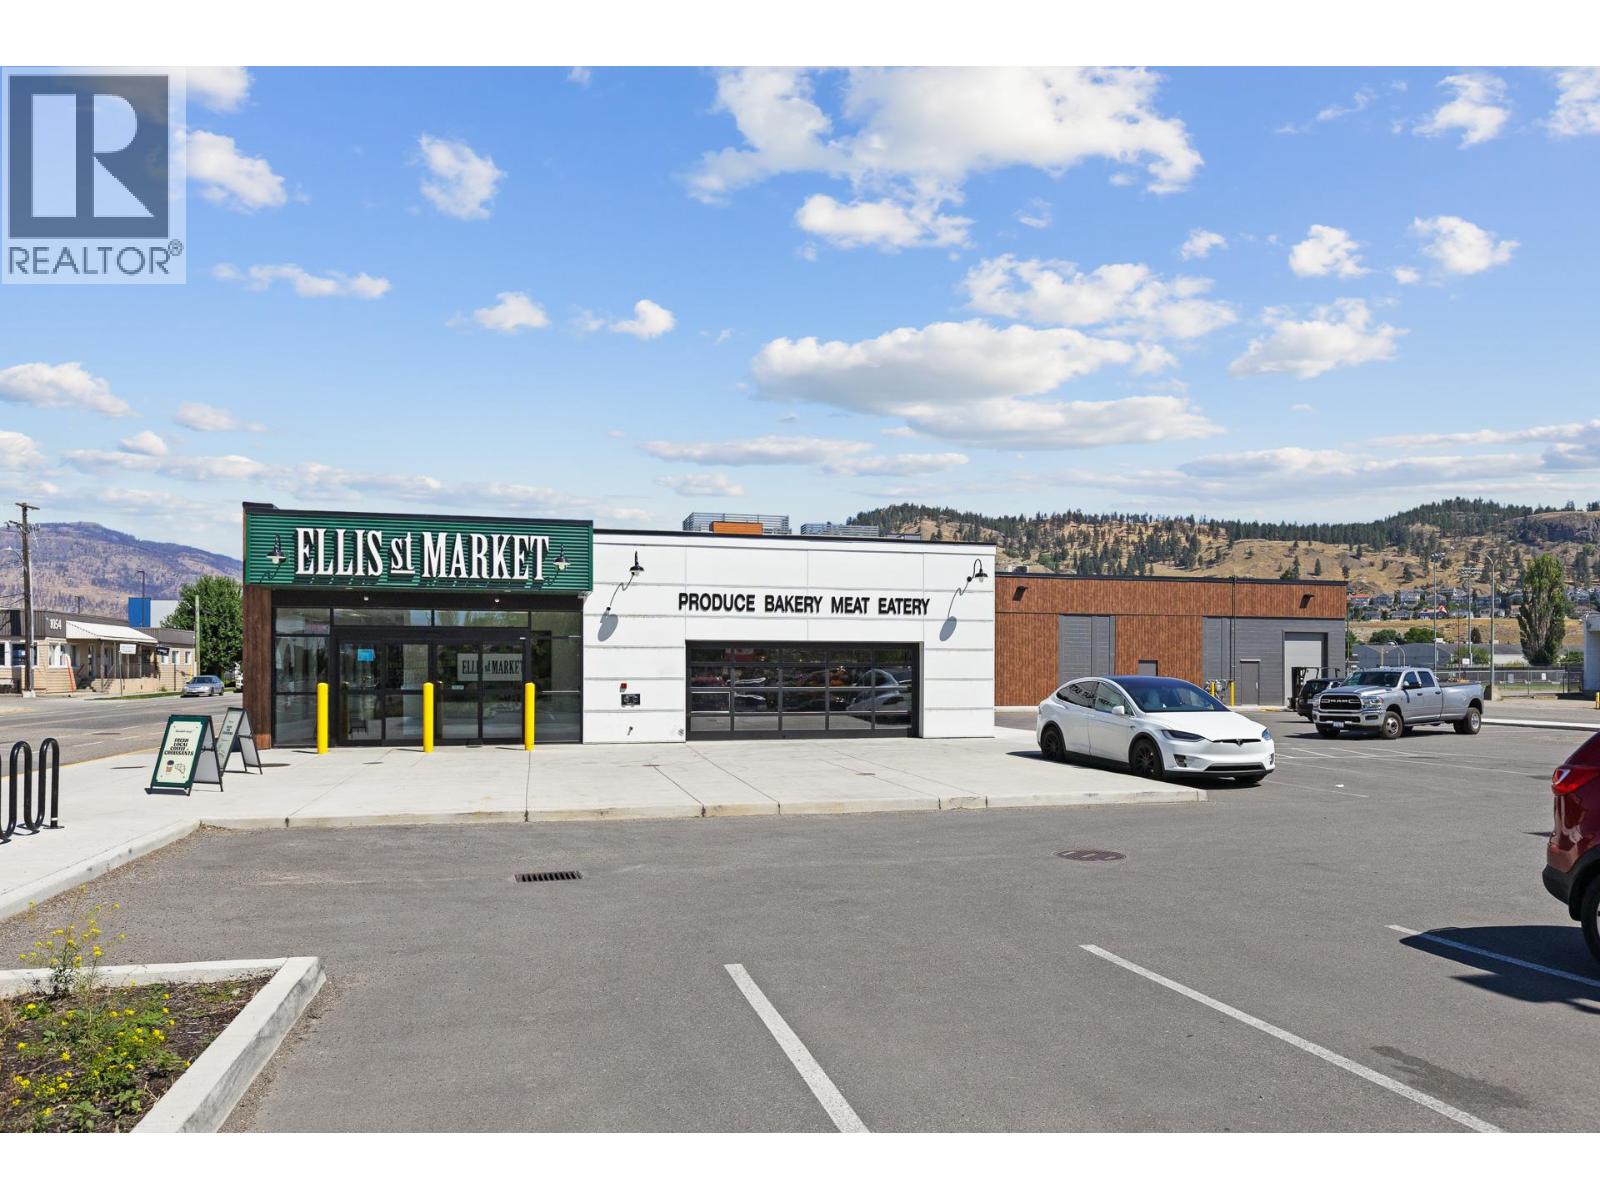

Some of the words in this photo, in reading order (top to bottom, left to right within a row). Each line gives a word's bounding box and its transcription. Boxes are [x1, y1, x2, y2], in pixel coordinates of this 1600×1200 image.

[296, 527, 384, 577] ELLIS
[390, 531, 416, 574] st
[422, 531, 550, 581] MARKET
[678, 592, 756, 613] PRODUCE
[764, 594, 823, 614] BAKERY
[831, 596, 870, 615] MEAT
[878, 597, 930, 616] EATERY
[462, 659, 478, 675] ELL
